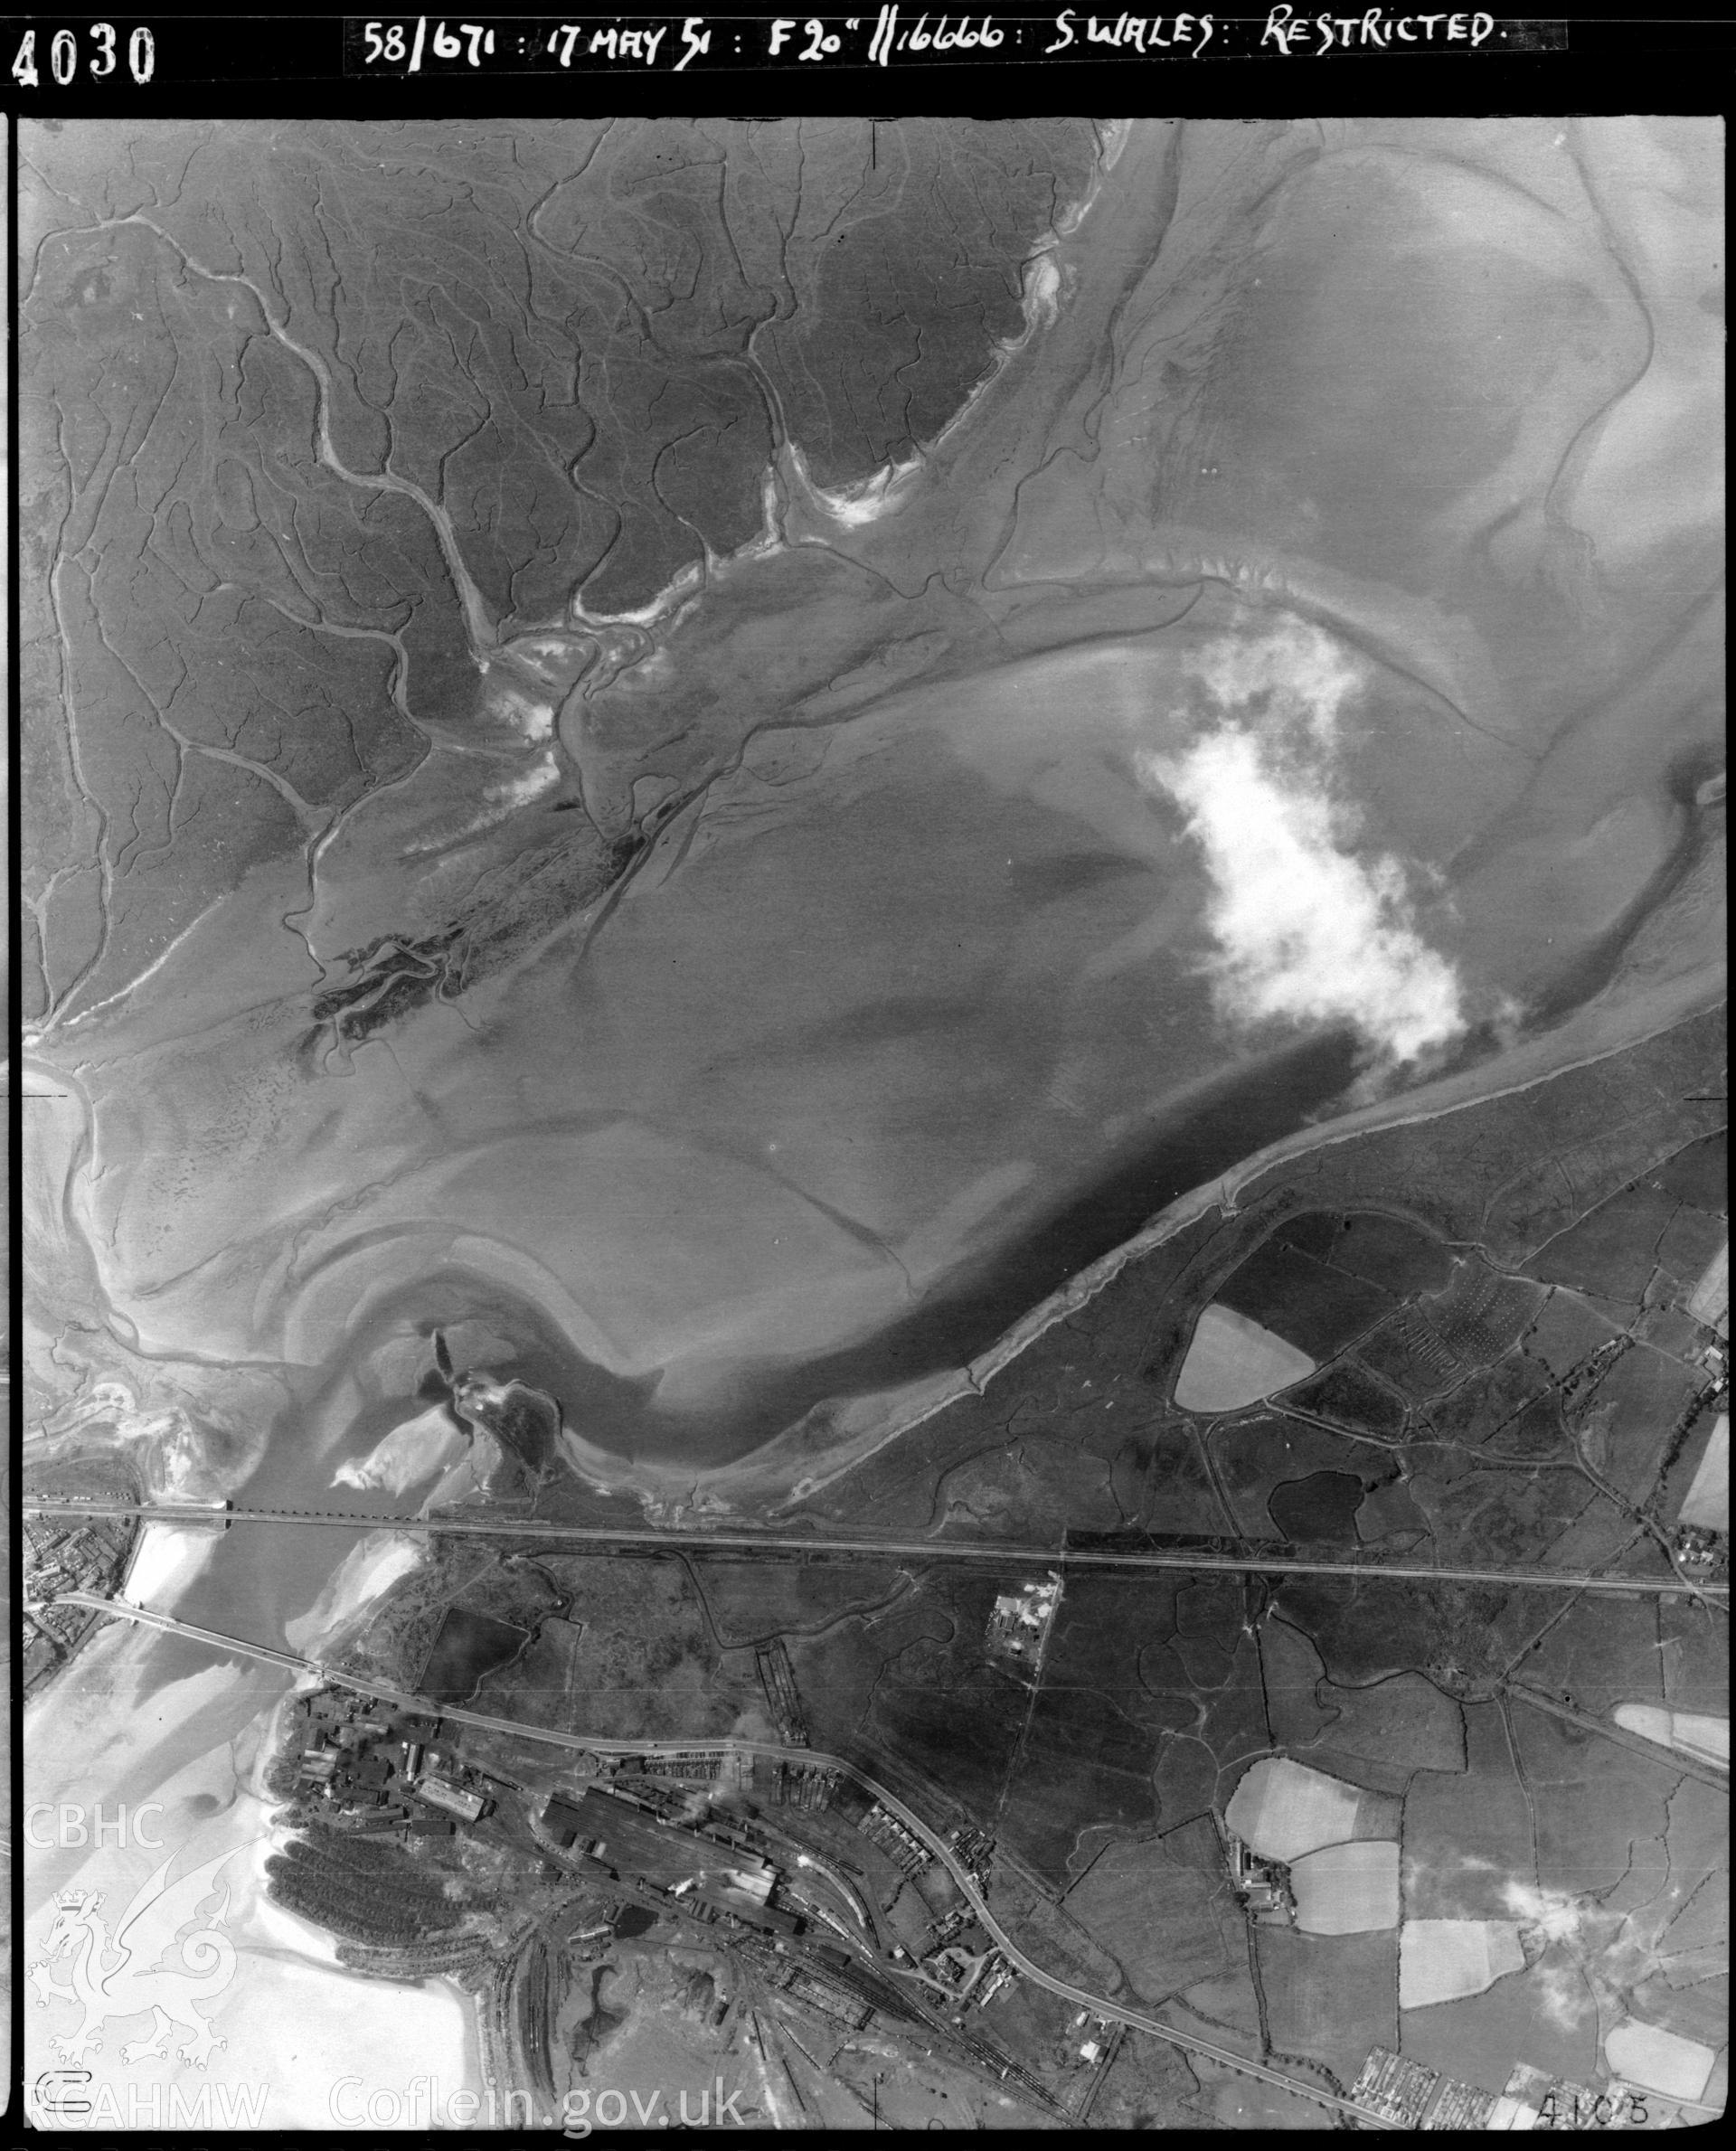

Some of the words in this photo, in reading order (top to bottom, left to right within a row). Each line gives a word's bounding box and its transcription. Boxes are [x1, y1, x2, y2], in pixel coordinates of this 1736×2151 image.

[12, 23, 155, 88] 4030
[590, 25, 667, 65] MAY
[673, 17, 712, 71] 51
[1537, 2094, 1648, 2127] 4105
